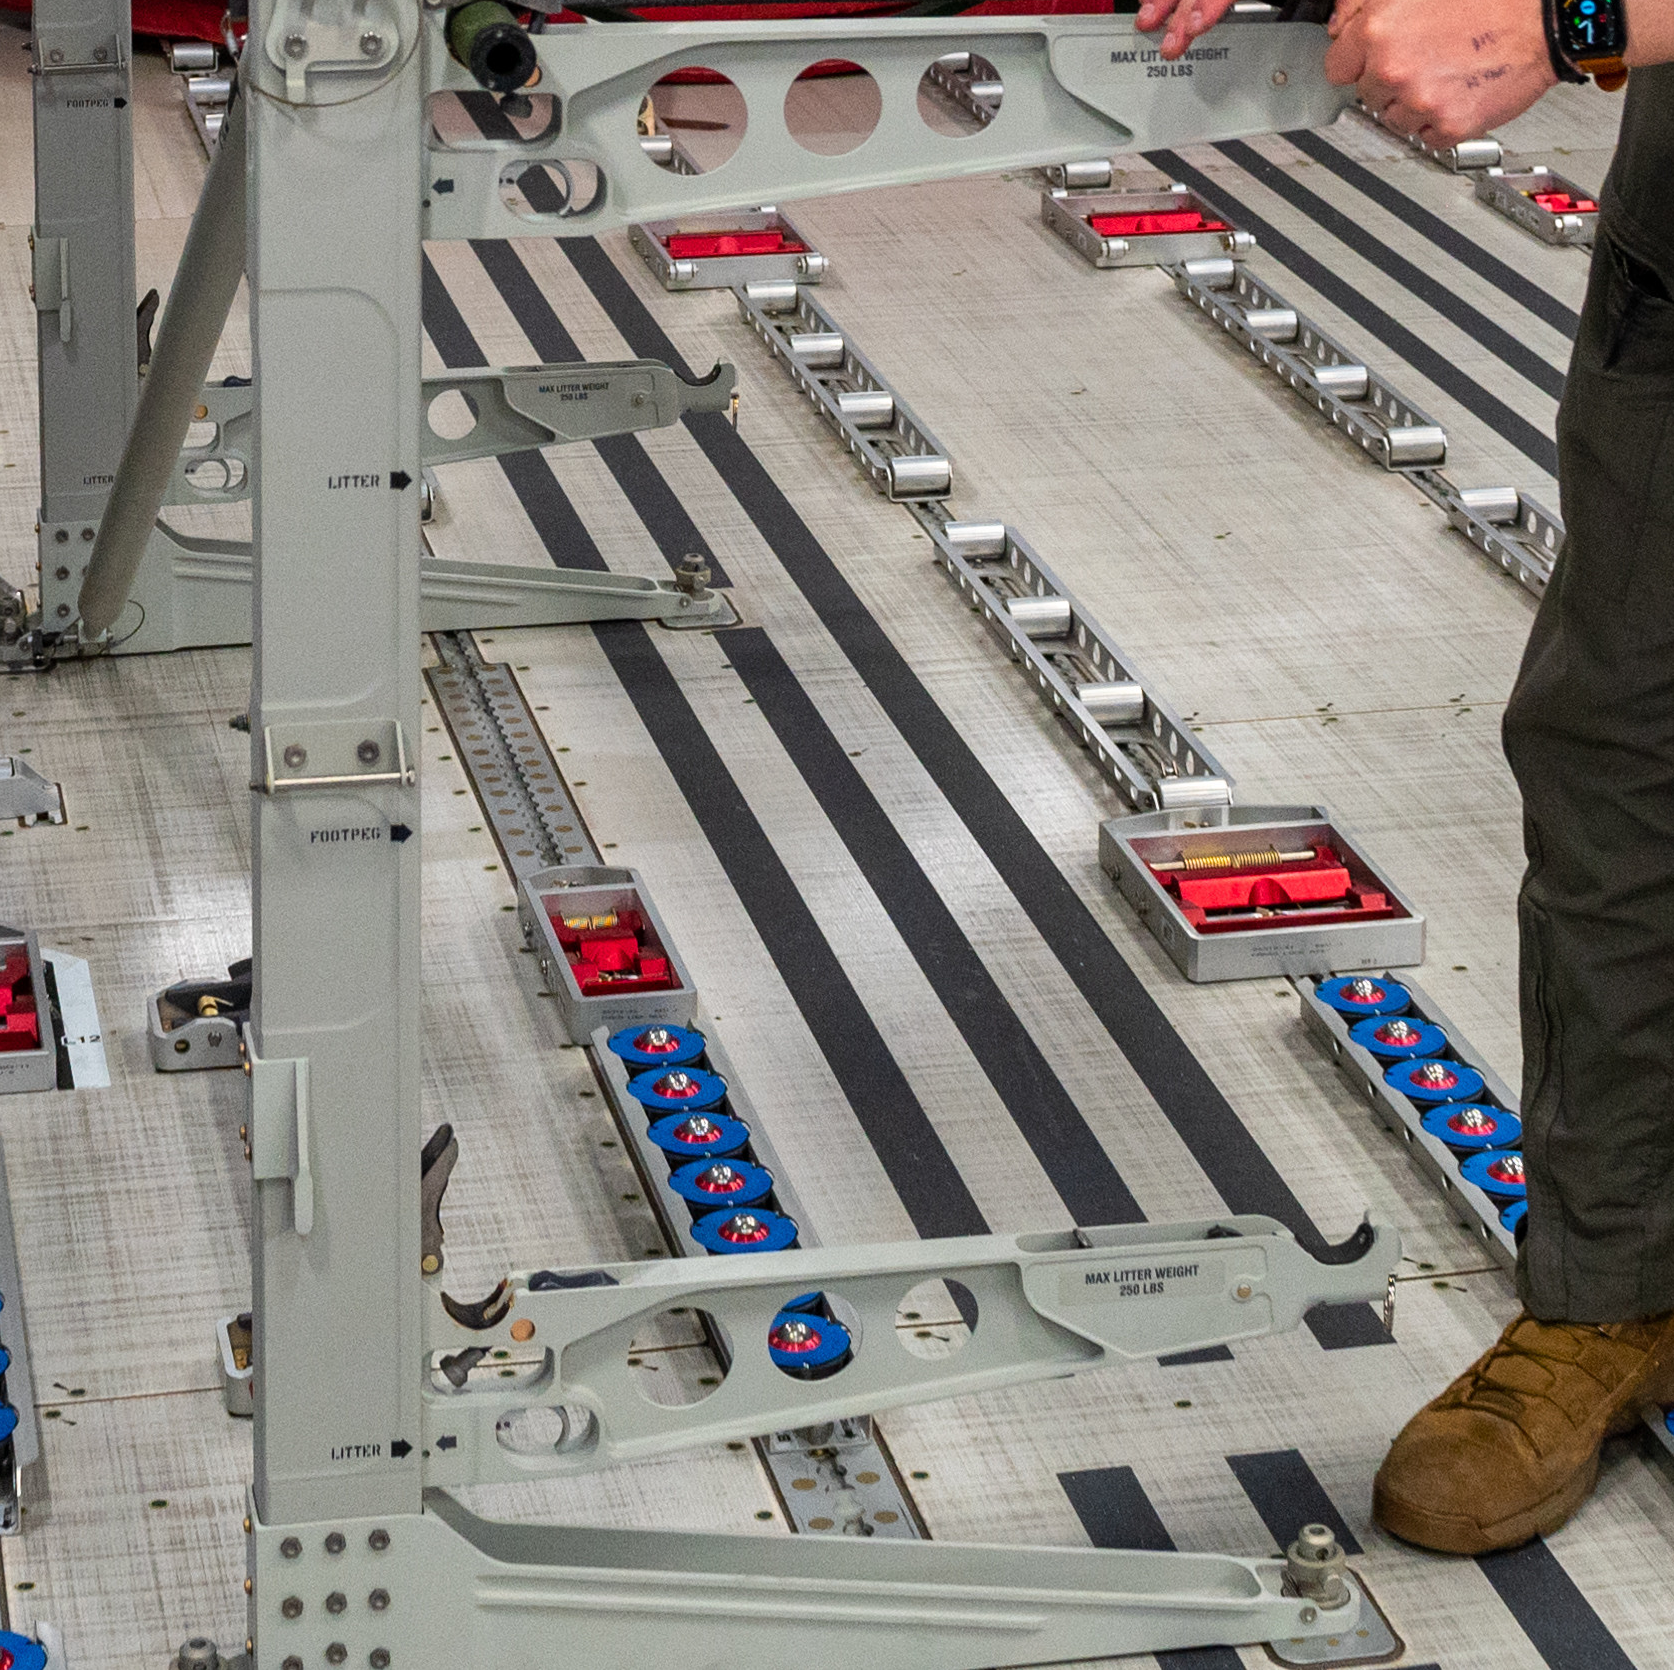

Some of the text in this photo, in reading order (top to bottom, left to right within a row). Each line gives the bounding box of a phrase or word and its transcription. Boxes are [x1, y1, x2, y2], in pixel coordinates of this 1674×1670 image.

[1111, 47, 1230, 63] MAX LIT WEIGHT
[1146, 64, 1194, 78] 250 LBS
[66, 98, 109, 109] FOOTPEG
[538, 382, 610, 394] MAX LITTER WEIGHT
[560, 392, 588, 401] 250 LBS
[83, 475, 114, 485] LITTER
[328, 474, 380, 490] LITTER
[310, 826, 381, 844] FOOTPEG
[1085, 1264, 1200, 1286] MAX LITTER WEIGHT
[1119, 1281, 1165, 1297] 250 LBS
[331, 1443, 381, 1461] LITTER
